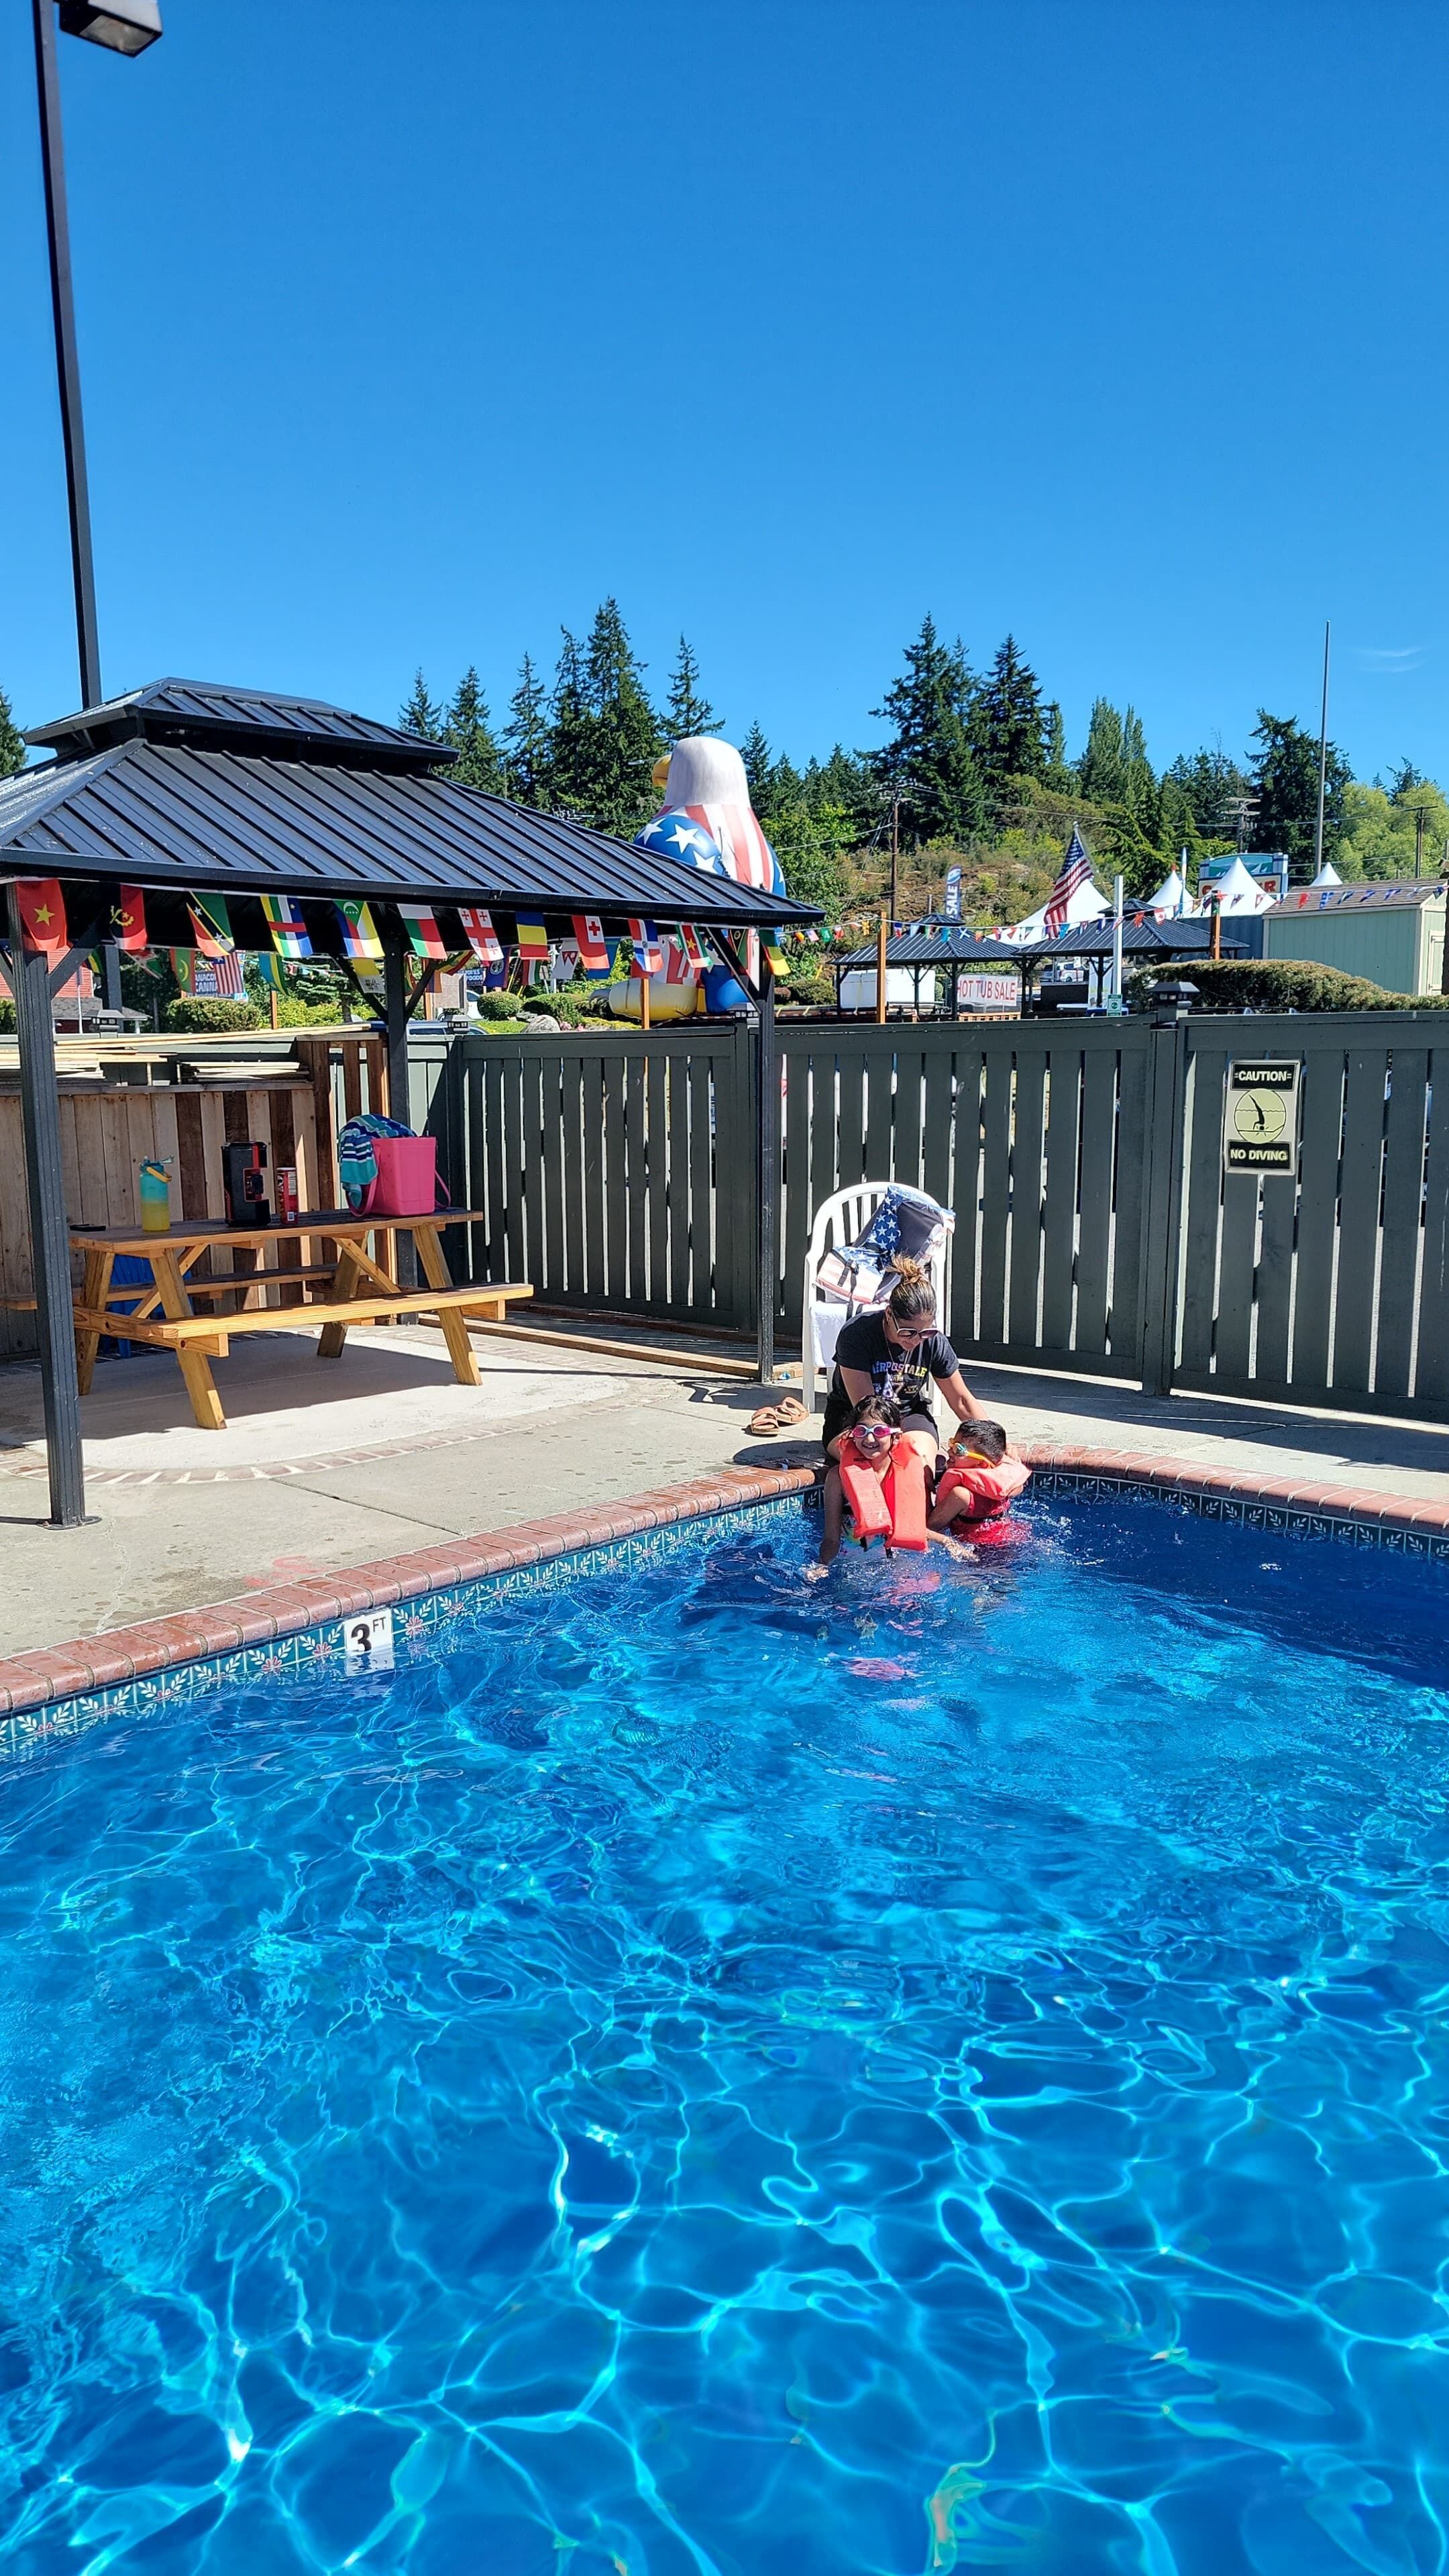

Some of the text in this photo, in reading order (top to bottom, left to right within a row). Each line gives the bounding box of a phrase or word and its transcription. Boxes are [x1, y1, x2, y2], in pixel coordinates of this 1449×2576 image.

[947, 885, 959, 915] SALE
[957, 980, 1016, 1000] HOT TUB SALE
[1238, 1071, 1287, 1081] CAUTION
[1230, 1149, 1288, 1161] NO DIVING
[351, 1617, 386, 1652] 3 FT
